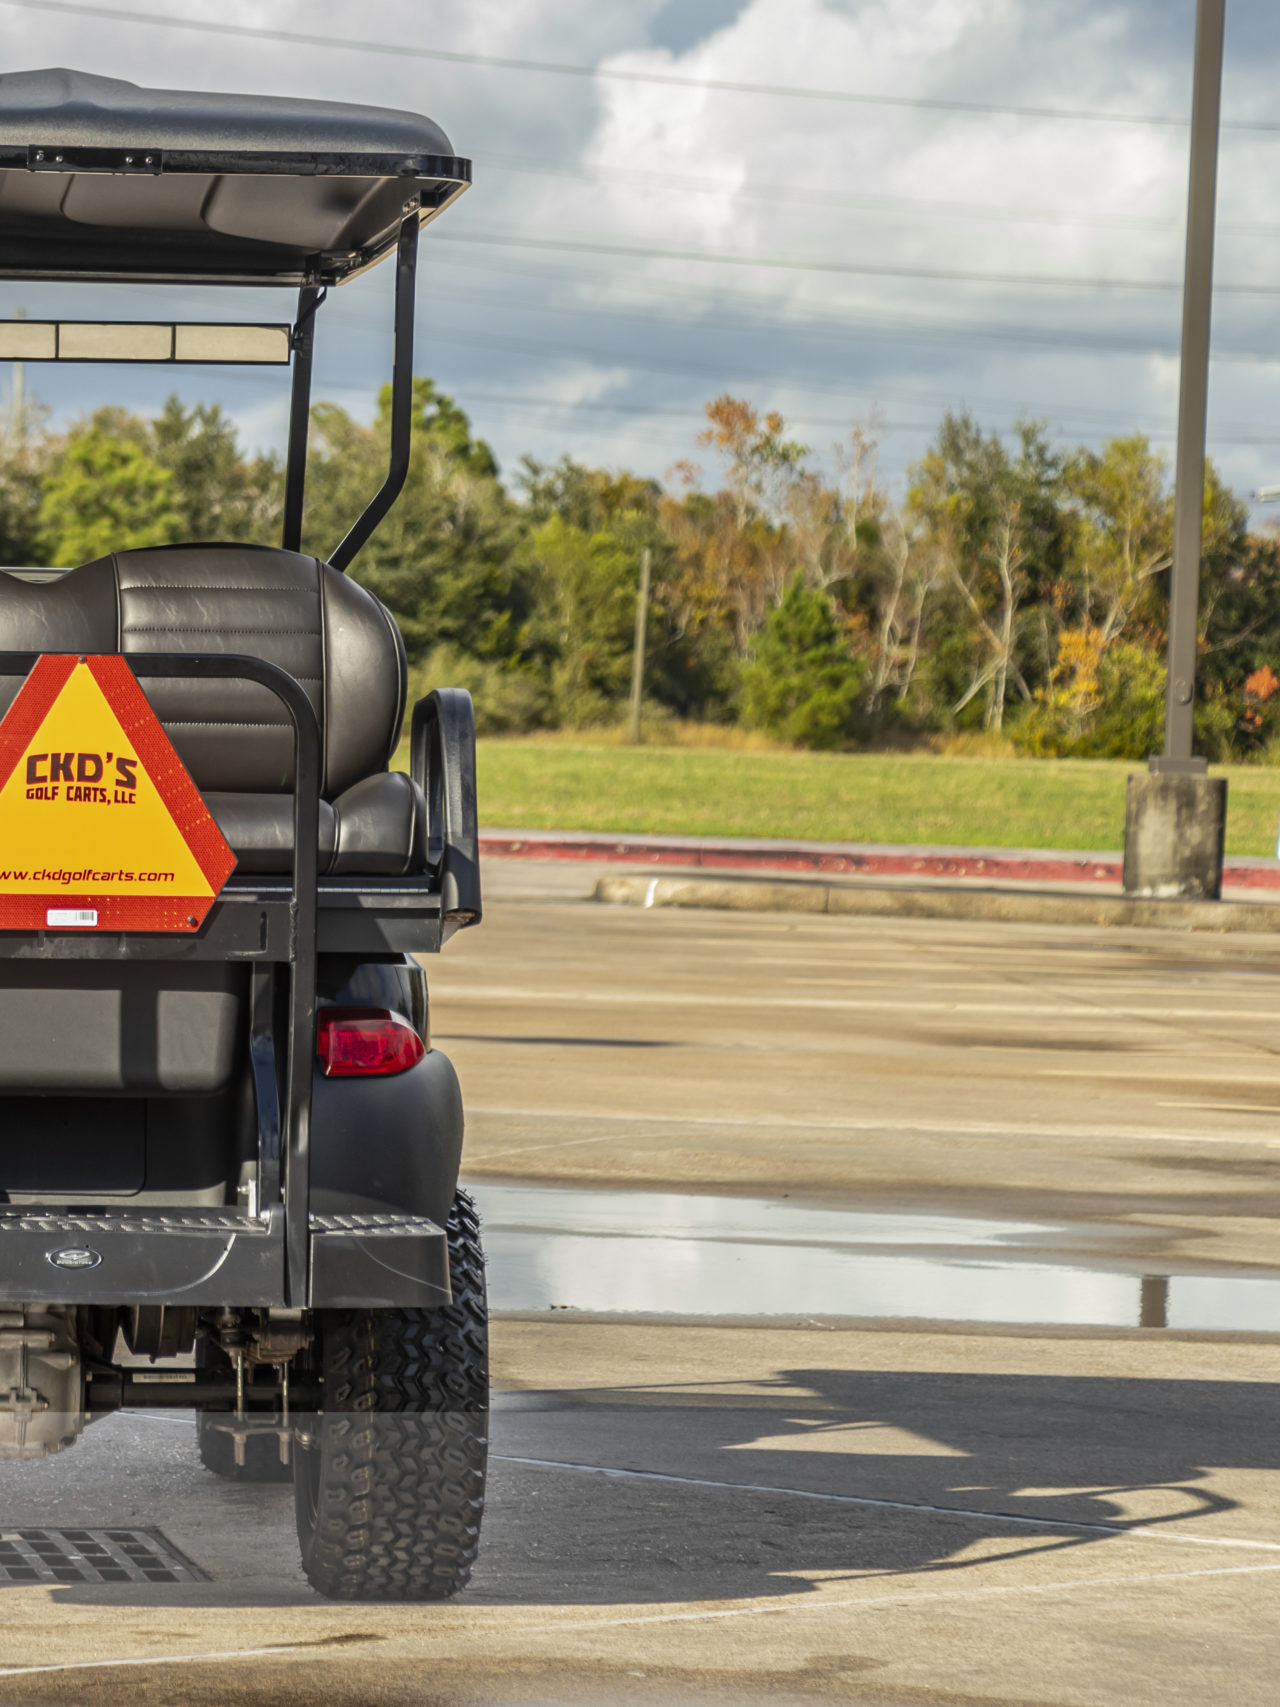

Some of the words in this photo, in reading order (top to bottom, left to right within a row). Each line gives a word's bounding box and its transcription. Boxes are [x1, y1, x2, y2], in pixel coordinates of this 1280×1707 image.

[26, 752, 138, 790] CKD'S
[26, 786, 59, 801] GOLF
[66, 786, 111, 806] CARTS,
[114, 790, 136, 804] LLC
